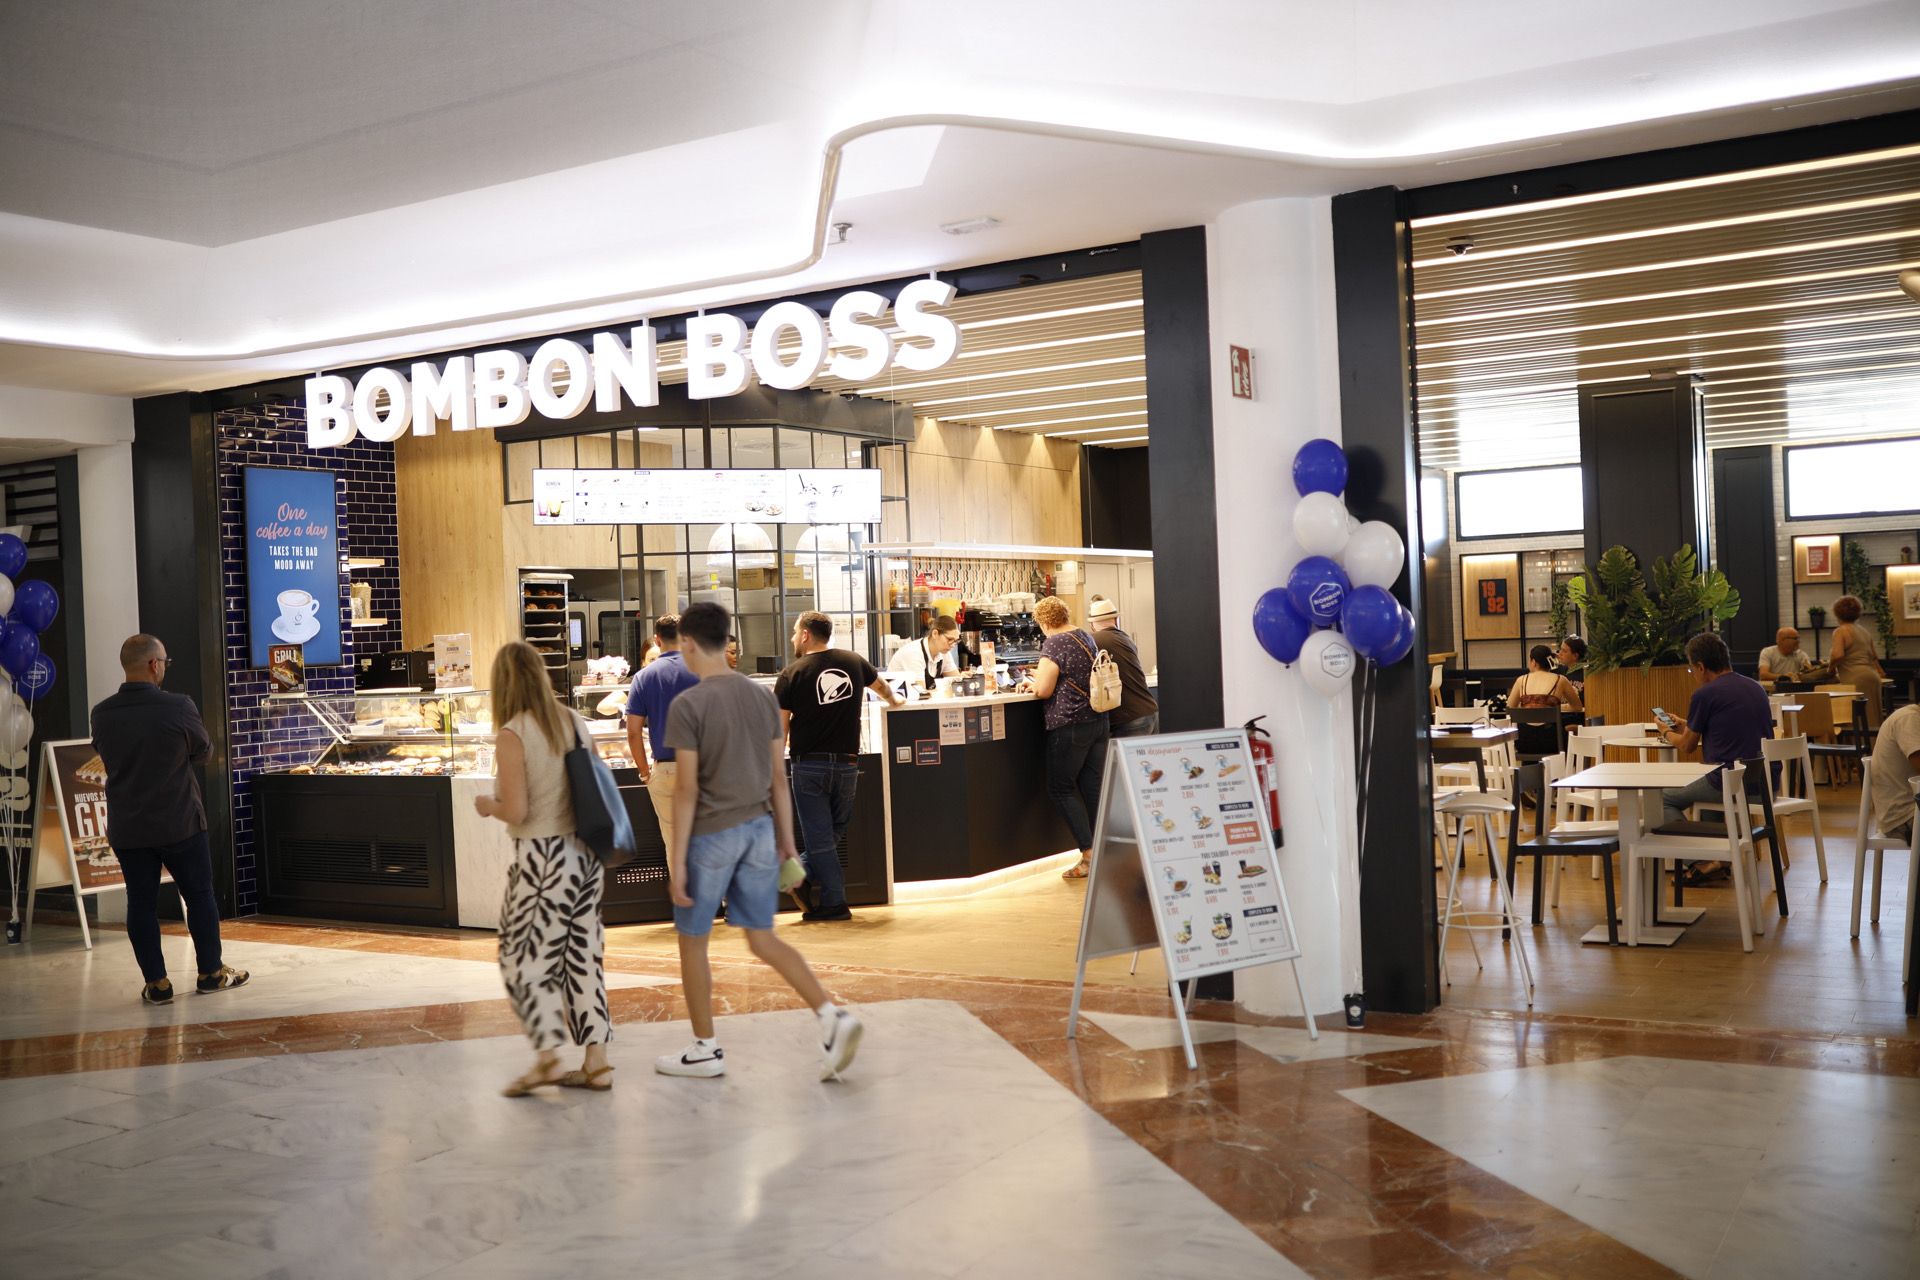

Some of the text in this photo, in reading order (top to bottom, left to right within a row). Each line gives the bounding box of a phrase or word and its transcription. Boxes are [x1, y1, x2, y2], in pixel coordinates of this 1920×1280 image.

[304, 280, 962, 449] BOMBON BOSS
[277, 502, 308, 522] One
[256, 522, 328, 540] coffee a day
[269, 546, 318, 557] TAKES THE BAD
[274, 560, 314, 570] MOOD AWAY
[1314, 590, 1341, 605] BOMBON
[274, 649, 299, 664] GRILL
[74, 792, 99, 803] NUEVOS
